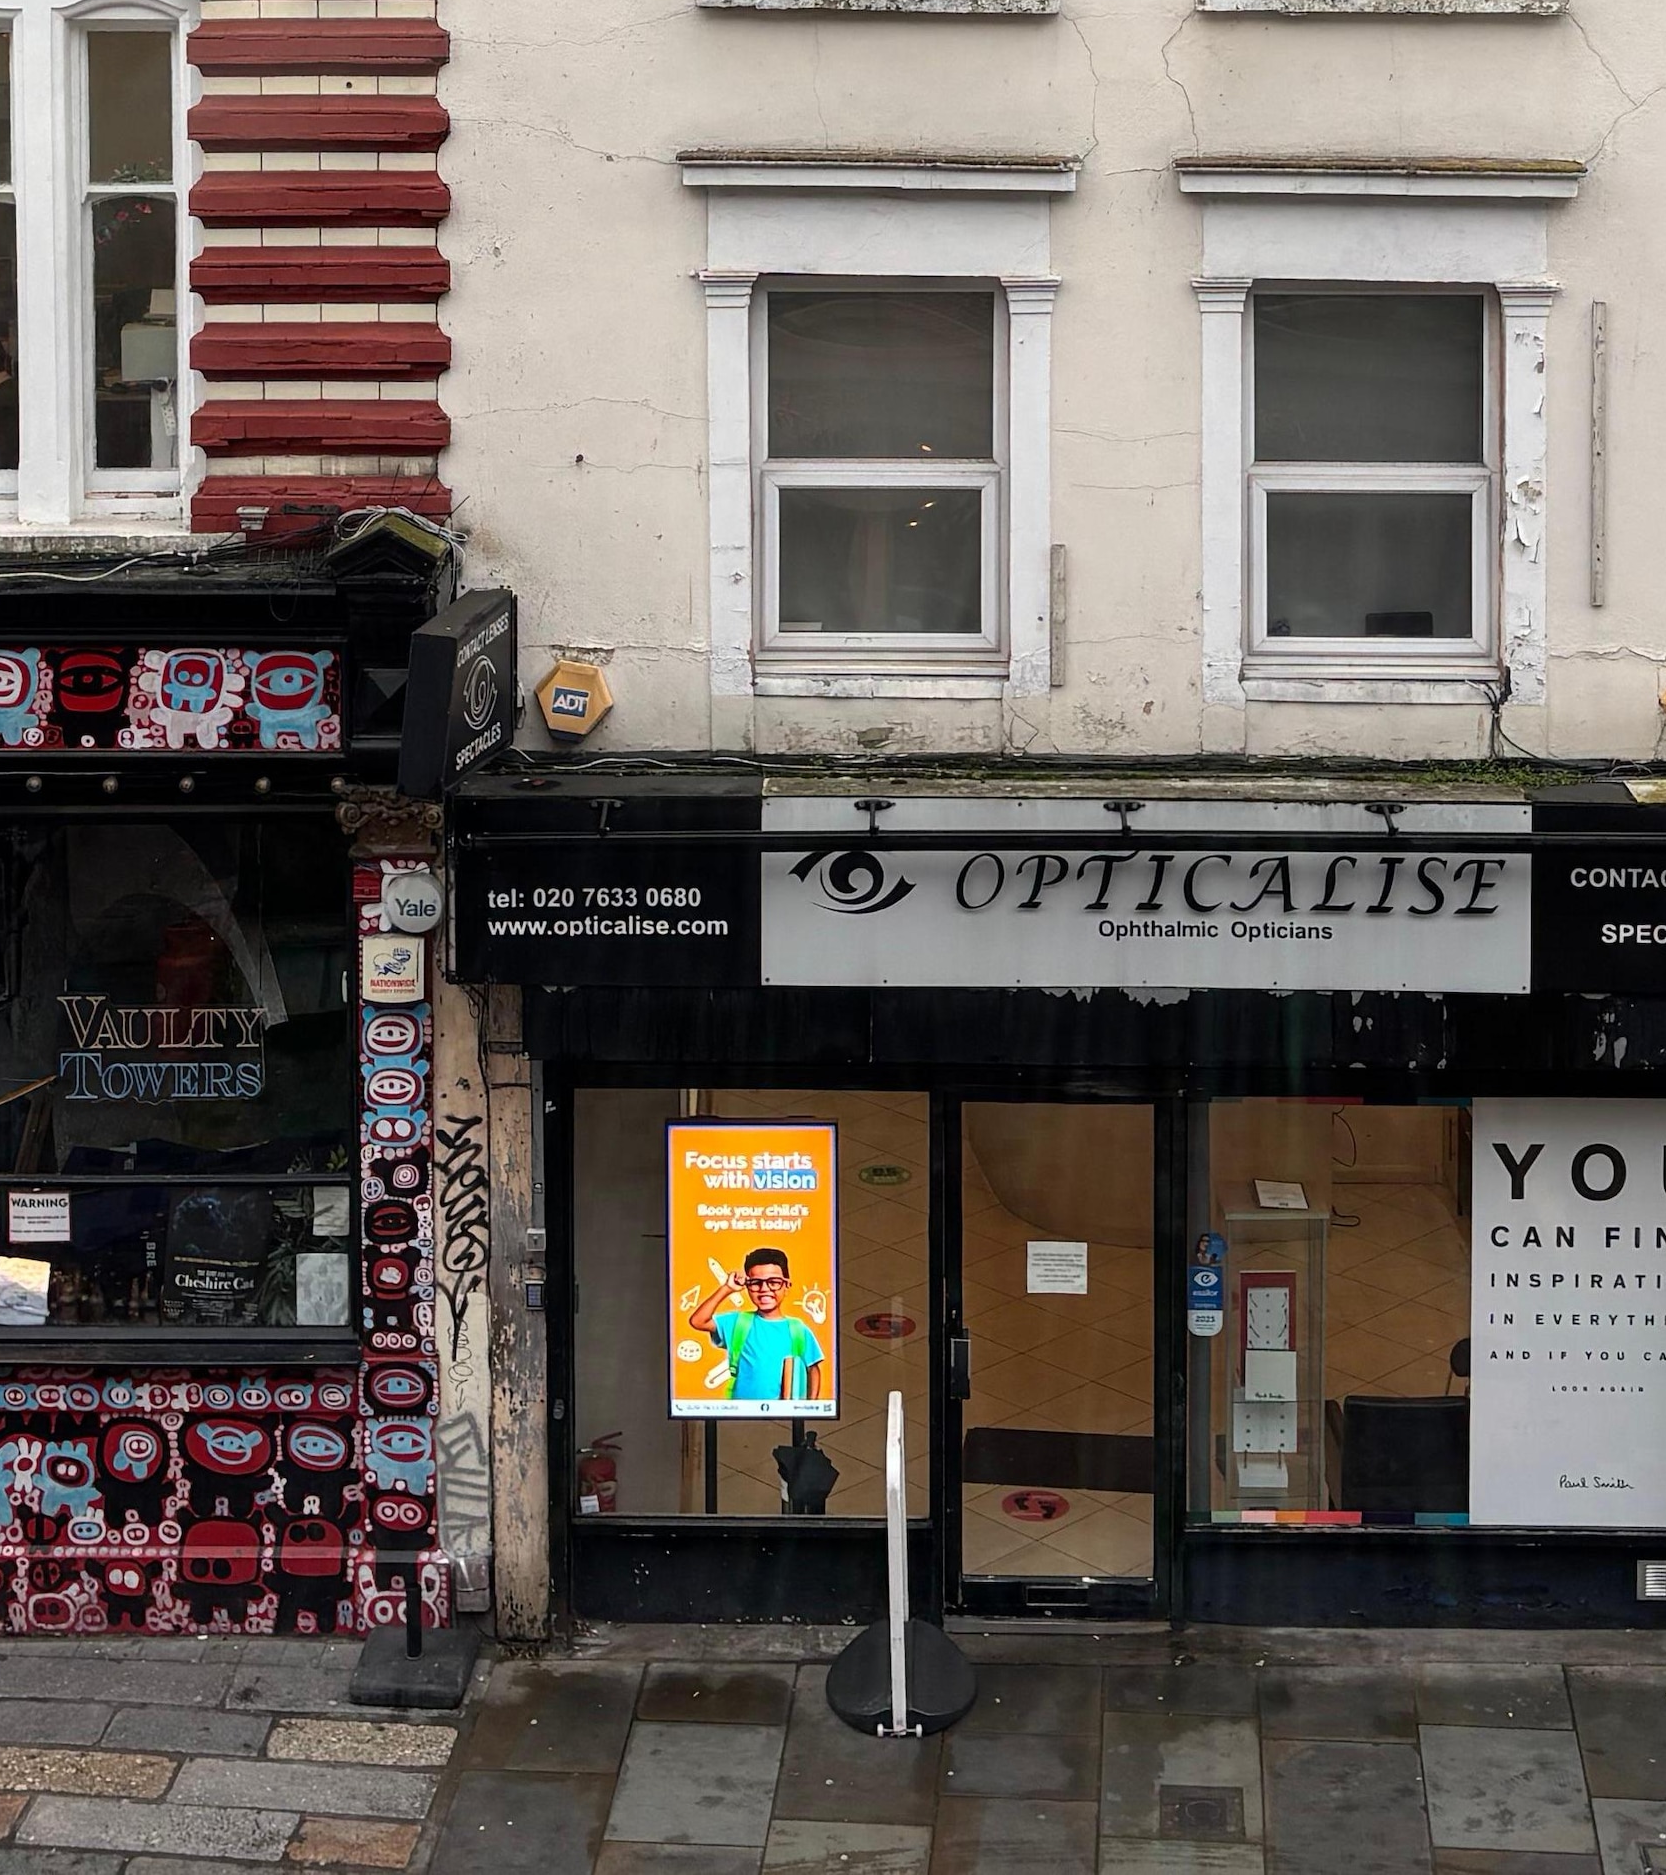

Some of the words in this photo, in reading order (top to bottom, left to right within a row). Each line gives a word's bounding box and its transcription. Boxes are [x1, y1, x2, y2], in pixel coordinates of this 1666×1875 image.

[457, 631, 486, 668] CONTACT
[484, 612, 509, 646] LENSES
[553, 693, 587, 712] ADT
[455, 722, 502, 771] SPECTACLES
[956, 851, 1506, 915] OPTICALISE
[395, 898, 436, 917] Yale
[488, 888, 524, 908] tel:
[533, 888, 575, 908] 020
[582, 888, 638, 907] 7633
[646, 888, 701, 907] 0680
[488, 915, 729, 937] www.opticalise.com
[1098, 920, 1219, 942] Ophthalmic
[1230, 921, 1333, 942] Opticians
[57, 996, 267, 1049] VAULTY
[60, 1053, 262, 1099] TOWERS
[685, 1150, 748, 1170] Focus
[752, 1152, 812, 1170] starts
[703, 1171, 750, 1190] with
[753, 1171, 817, 1190] vision
[11, 1198, 68, 1209] WARNING
[697, 1203, 732, 1217] Book
[733, 1206, 764, 1219] your
[1491, 1226, 1575, 1248] CAN
[174, 1273, 231, 1290] Cheshire
[1490, 1313, 1514, 1325] IN
[1490, 1351, 1531, 1361] AND
[1549, 1351, 1567, 1361] IF
[1585, 1351, 1625, 1361] YOU
[1559, 1475, 1589, 1489] Paul
[1593, 1476, 1635, 1490] Smith
